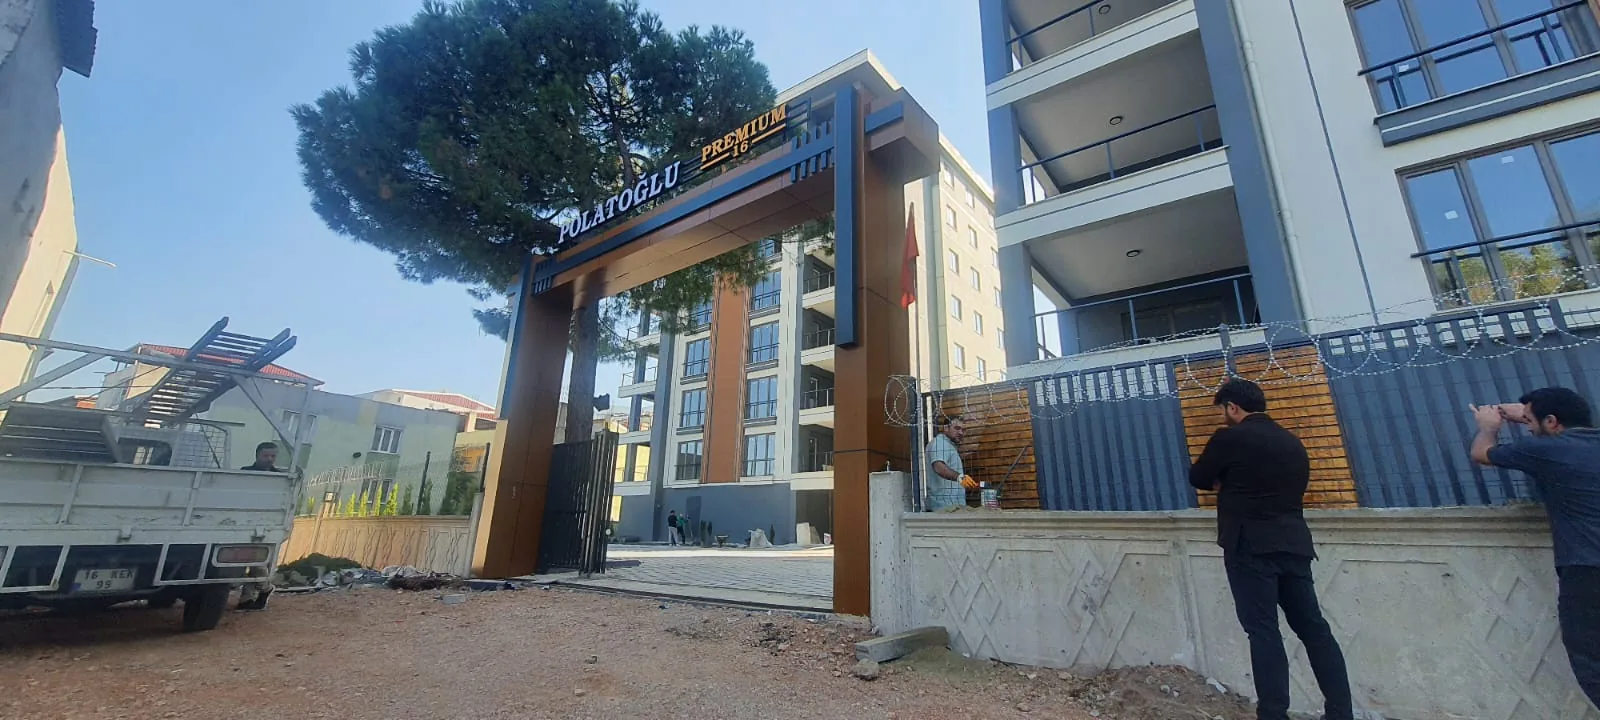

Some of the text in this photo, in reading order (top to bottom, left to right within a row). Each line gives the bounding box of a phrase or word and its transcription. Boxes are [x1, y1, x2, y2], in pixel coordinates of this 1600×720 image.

[702, 103, 786, 162] PREMIUM
[732, 140, 749, 157] 16
[558, 160, 681, 244] POLATOĞLU
[84, 571, 98, 580] 16
